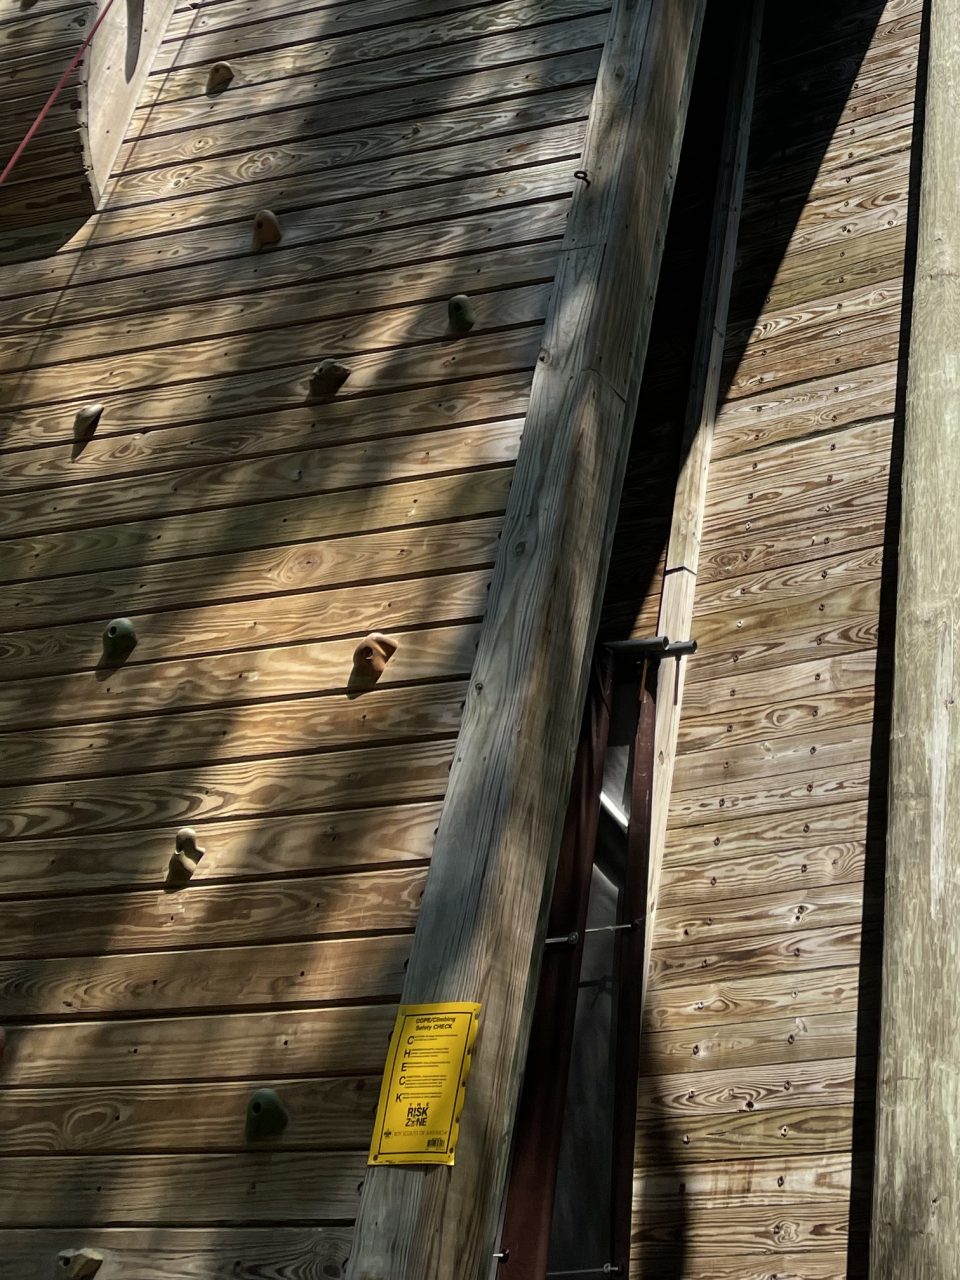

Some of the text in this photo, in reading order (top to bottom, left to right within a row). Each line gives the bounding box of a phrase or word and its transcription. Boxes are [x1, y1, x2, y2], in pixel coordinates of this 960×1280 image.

[407, 1035, 415, 1045] C
[403, 1049, 411, 1058] H
[401, 1062, 407, 1072] E
[399, 1075, 406, 1086] C
[396, 1093, 403, 1103] K
